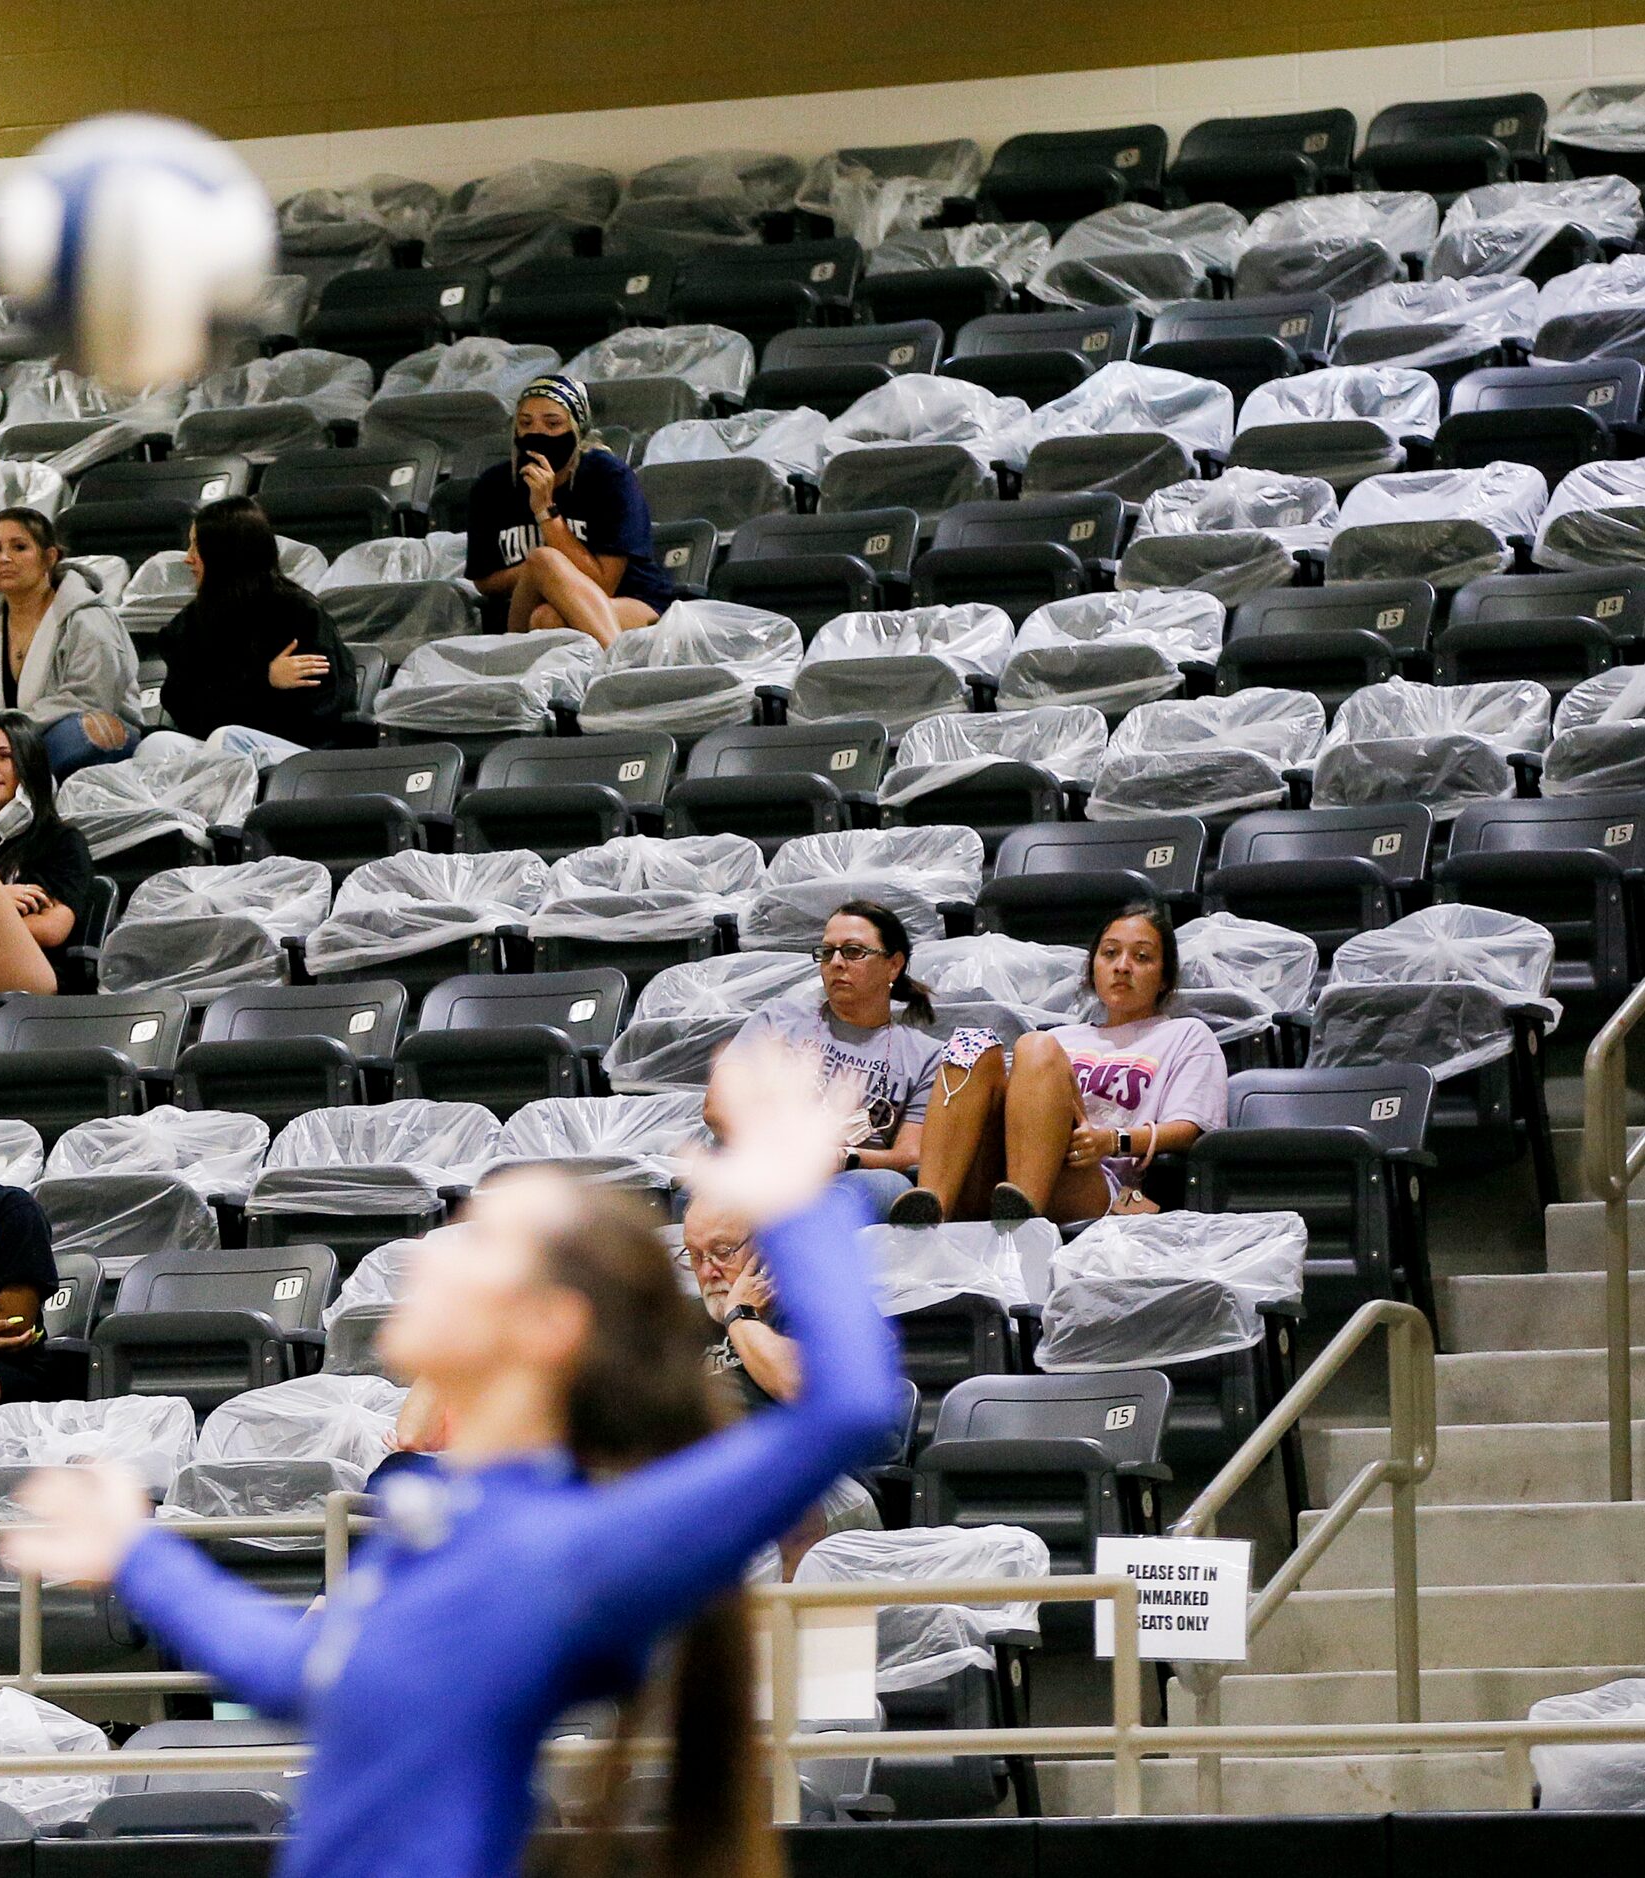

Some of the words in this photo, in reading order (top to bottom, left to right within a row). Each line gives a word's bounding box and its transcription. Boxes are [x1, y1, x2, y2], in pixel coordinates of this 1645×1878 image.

[1076, 523, 1089, 537] 11
[870, 538, 886, 552] 10
[1602, 600, 1617, 613] 14
[837, 752, 852, 766] 11
[624, 763, 640, 776] 10
[415, 775, 424, 789] 9
[1610, 826, 1627, 841] 15
[1378, 837, 1394, 853] 14
[1152, 849, 1168, 864] 13
[355, 1015, 371, 1029] 10
[802, 1039, 866, 1068] KAUFMAN
[1377, 1100, 1395, 1117] 15
[282, 1280, 296, 1296] 11
[50, 1291, 66, 1308] 10
[1112, 1409, 1129, 1426] 15
[1127, 1564, 1173, 1580] PLEASE
[1178, 1565, 1200, 1581] SIT
[1204, 1566, 1218, 1581] IN
[1177, 1615, 1209, 1631] ONLY
